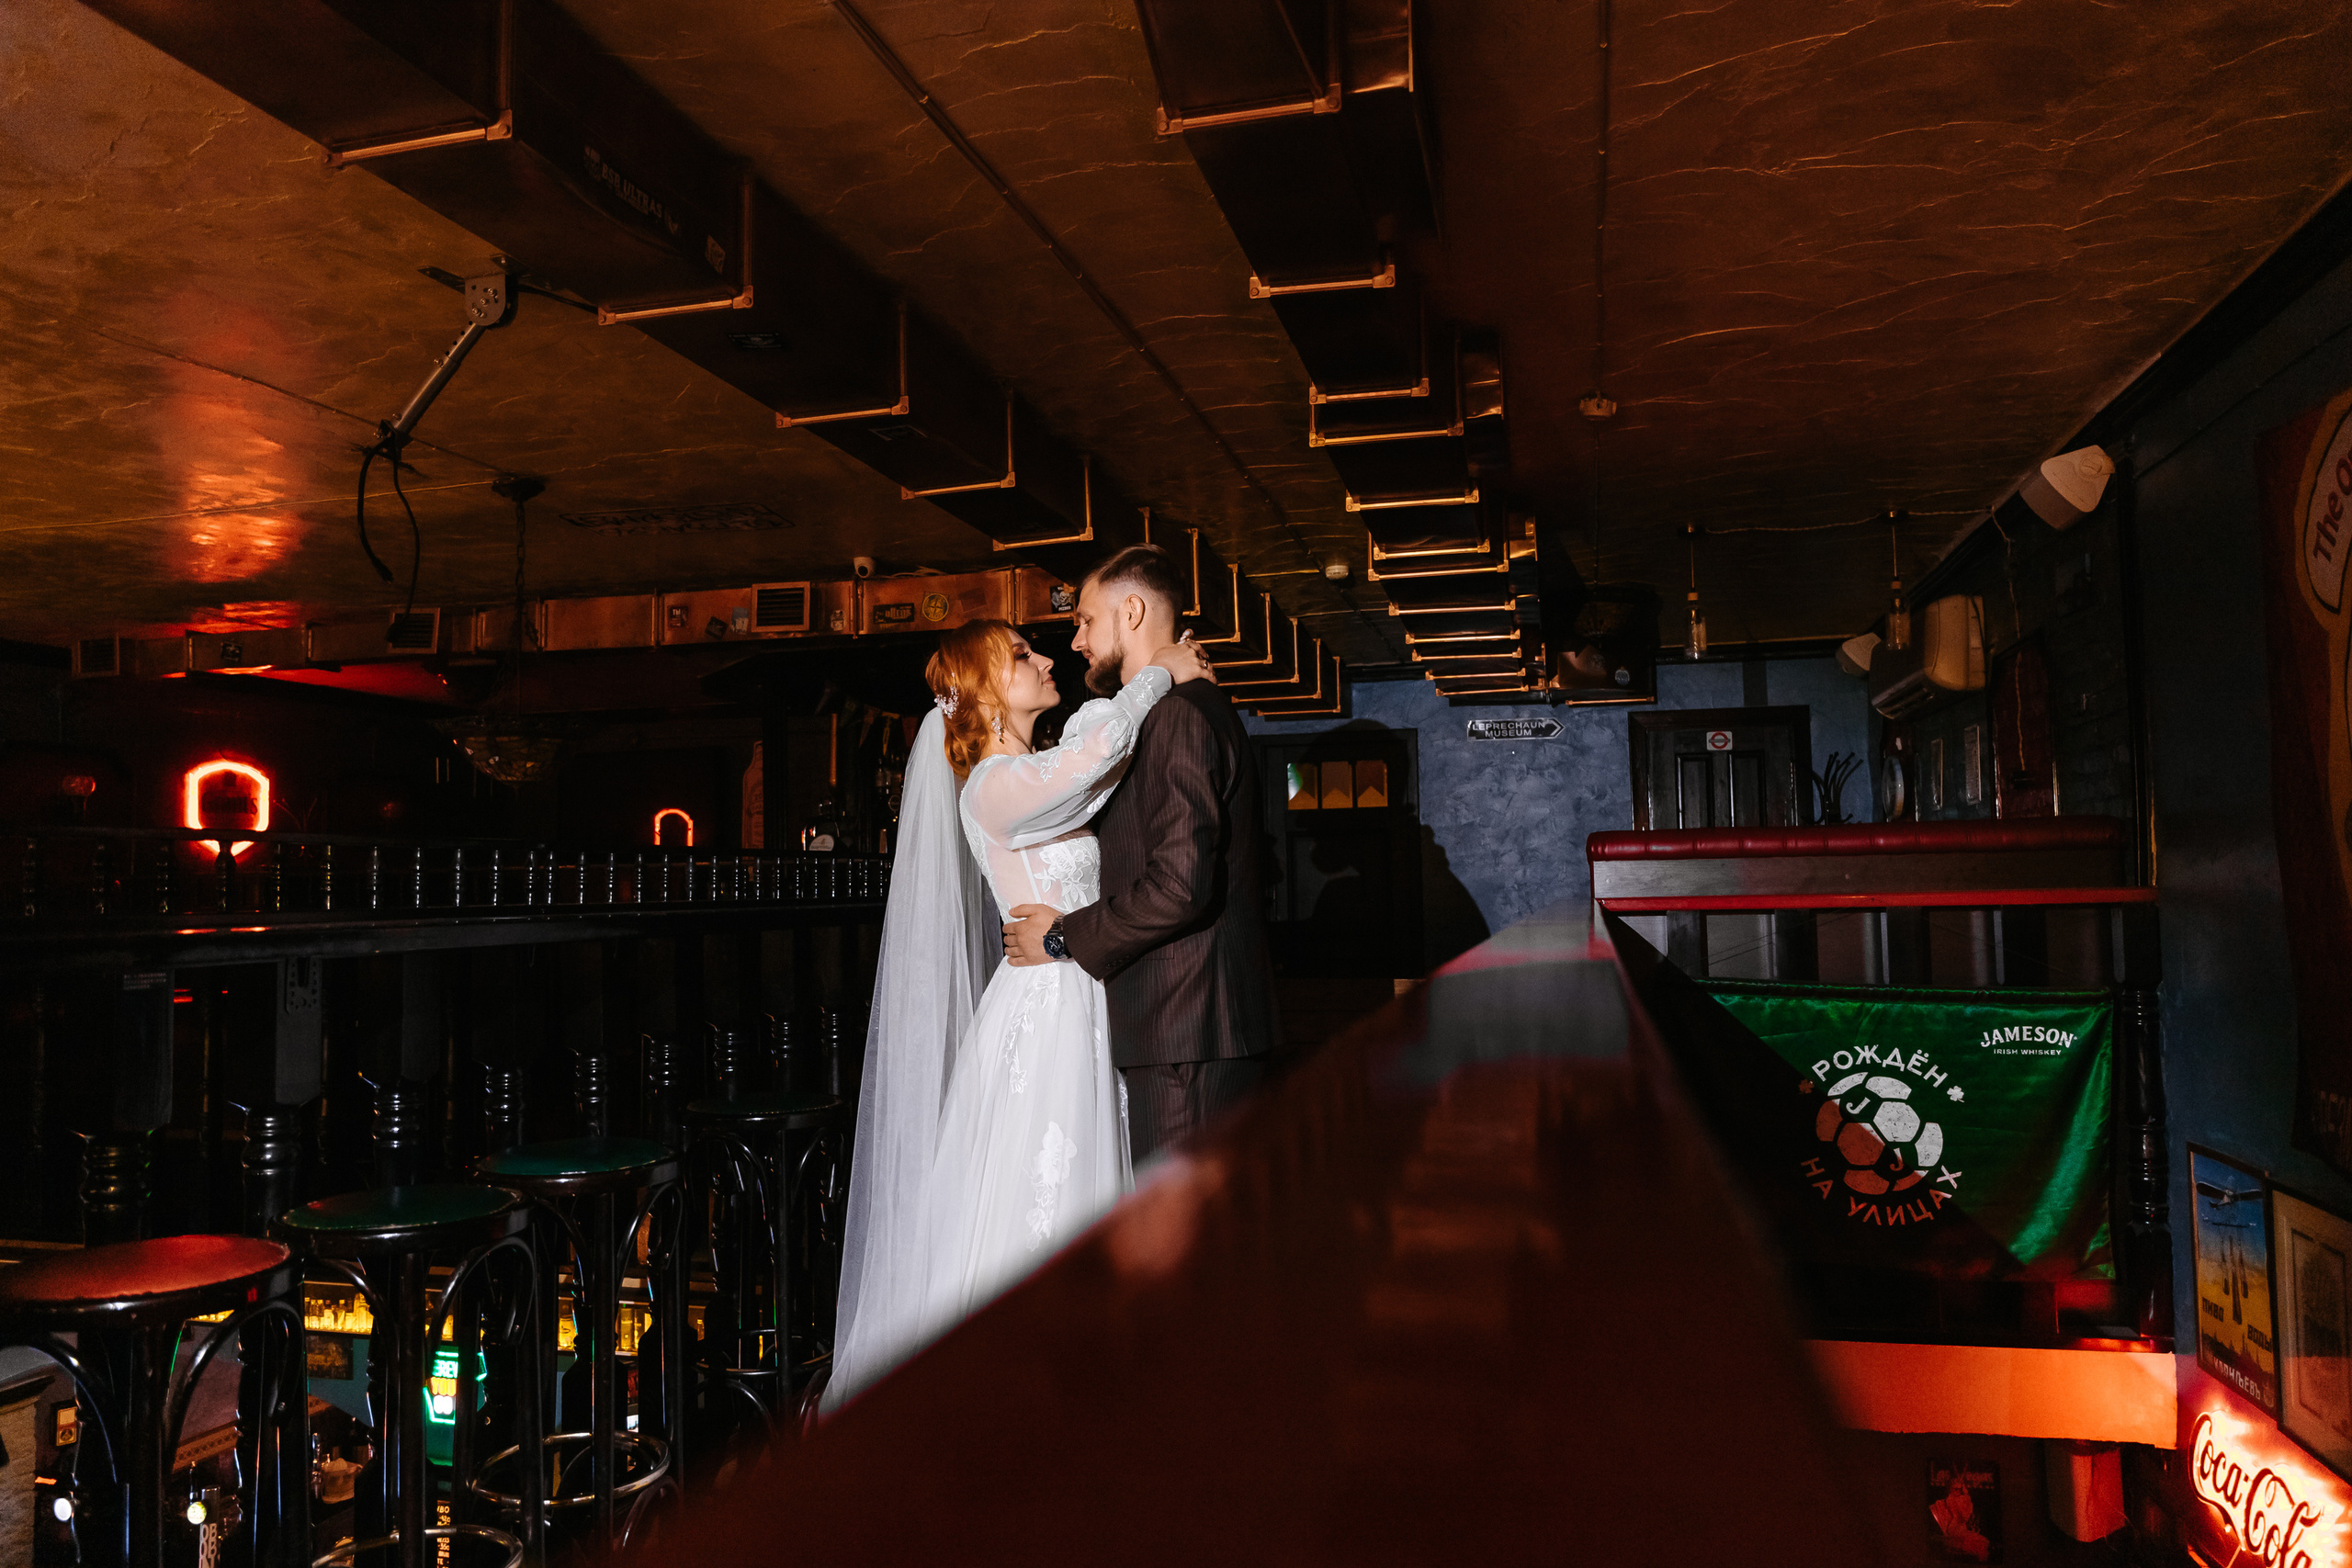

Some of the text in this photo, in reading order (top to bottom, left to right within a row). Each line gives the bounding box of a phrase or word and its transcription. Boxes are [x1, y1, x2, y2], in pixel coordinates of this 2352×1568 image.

[2312, 447, 2352, 563] The O
[1472, 721, 1545, 731] LEPRECHAUN
[1485, 728, 1532, 738] MUSEUM
[1980, 1025, 2075, 1049] JAMESON
[1811, 1043, 1949, 1089] РОЖДЁН
[1800, 1156, 1962, 1226] НА УЛИЦАХ
[431, 1376, 457, 1397] YOU
